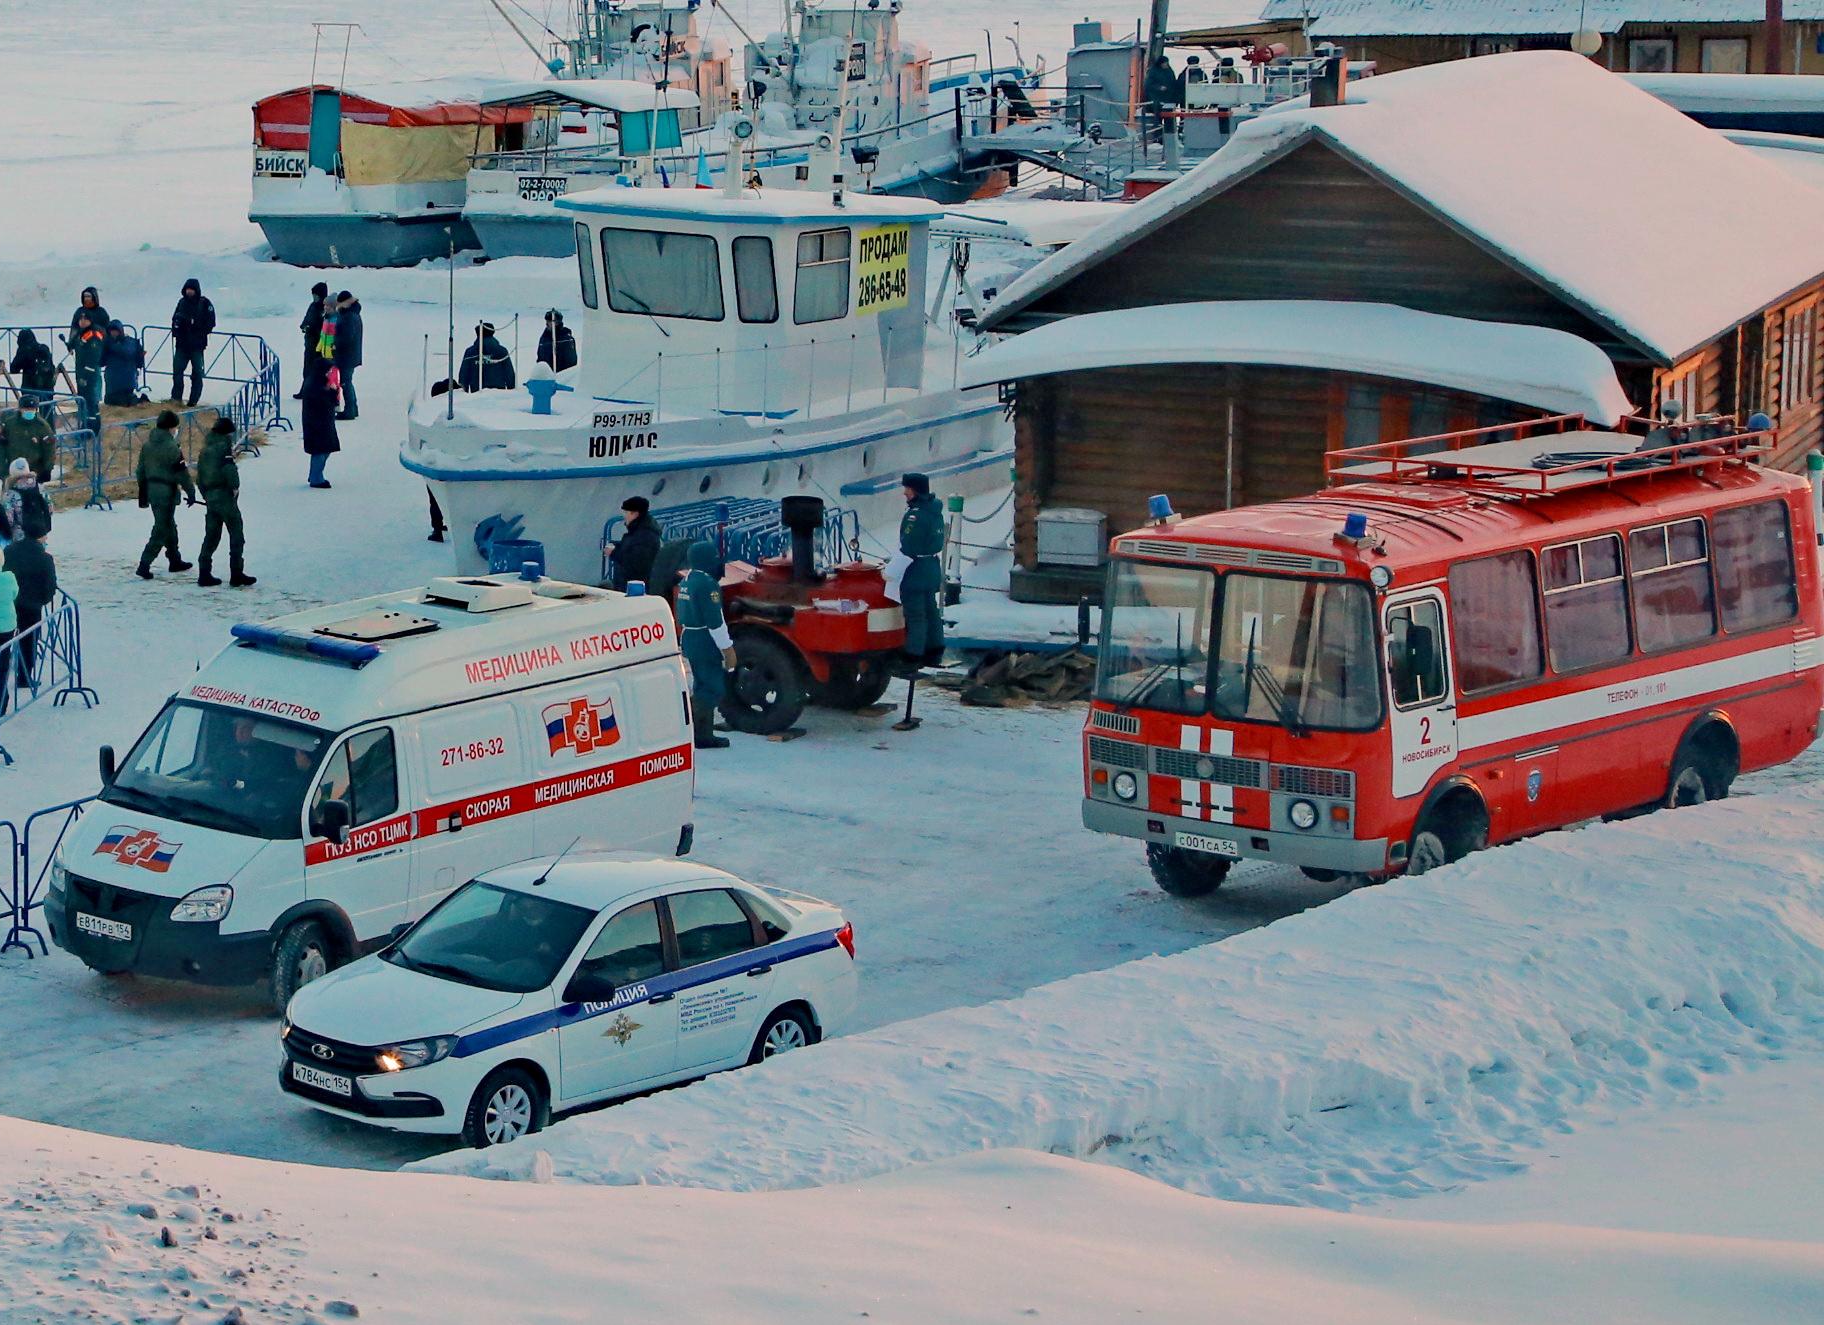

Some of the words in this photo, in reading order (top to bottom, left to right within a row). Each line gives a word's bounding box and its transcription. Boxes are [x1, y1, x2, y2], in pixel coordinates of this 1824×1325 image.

[255, 155, 305, 172] БИЙСК
[859, 230, 908, 264] ПРОДАМ
[858, 267, 907, 307] 286-65-48
[464, 644, 564, 684] МЕДИЦИНА
[570, 622, 665, 662] КАТАСТРОФ
[190, 685, 247, 705] МЕДИЦИНА
[249, 697, 321, 721] КАТАСТРОФ
[1607, 689, 1639, 703] ТЕЛЕФОН
[1420, 716, 1431, 745] 2
[440, 737, 505, 767] 271-86-32
[1402, 745, 1451, 764] НОВОСИБИРСК
[465, 795, 511, 820] СКОРАЯ
[534, 769, 615, 804] МЕДИЦИНСКАЯ
[639, 751, 686, 777] ПОМОЩЬ
[324, 839, 352, 859] ГКУЗ
[354, 830, 377, 851] НСО
[379, 819, 409, 843] ТЦМК
[295, 1066, 332, 1089] К784НС
